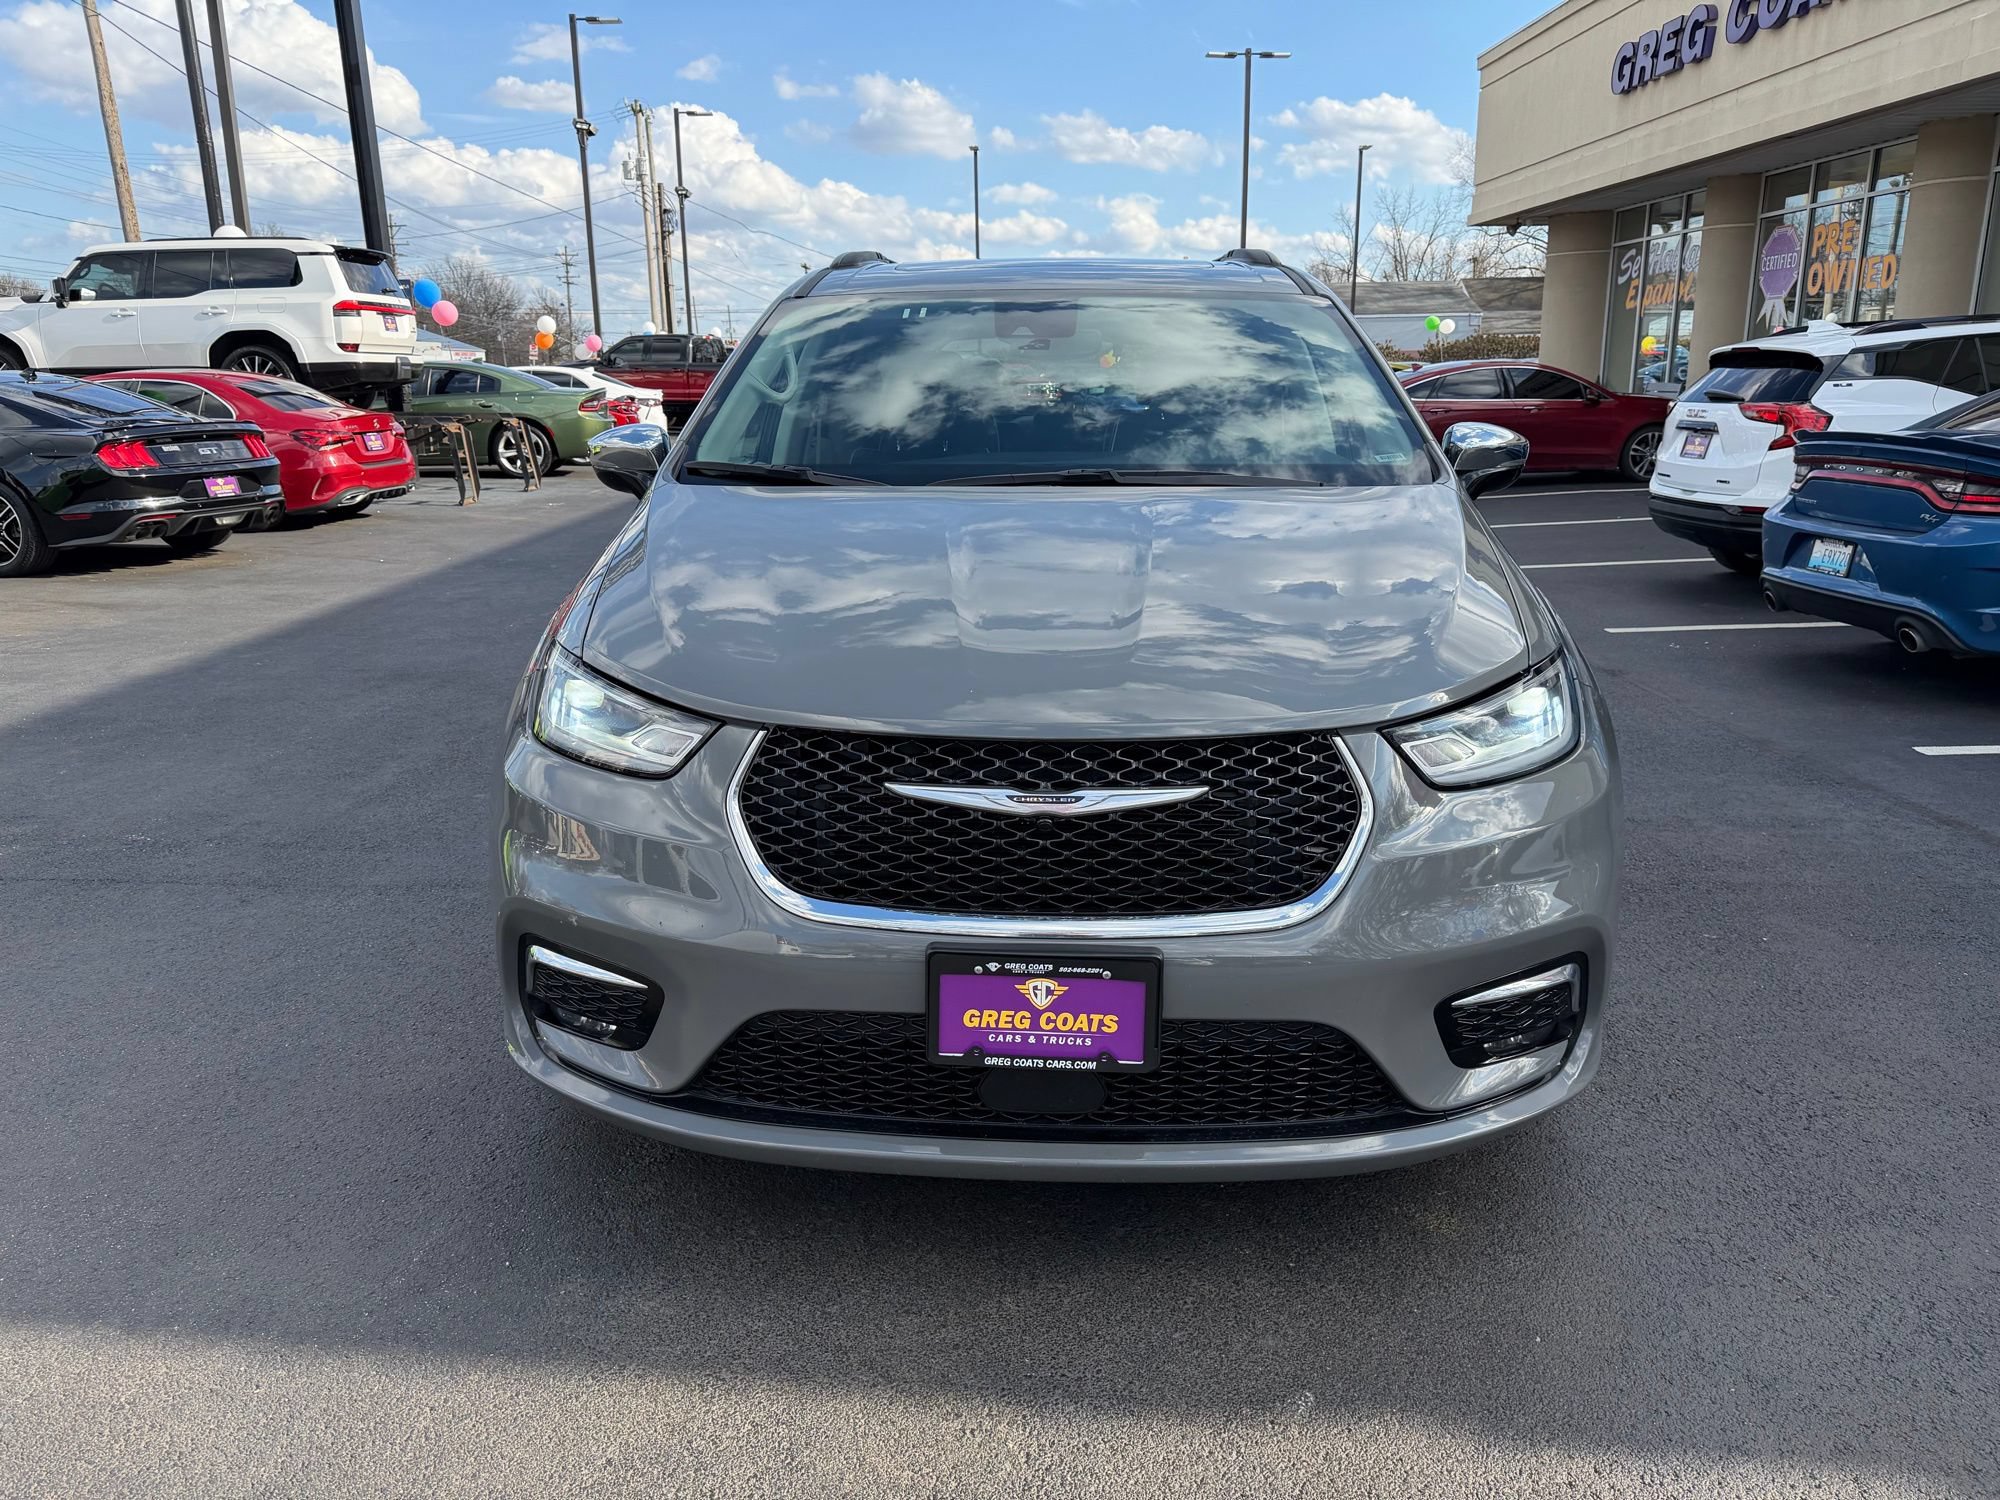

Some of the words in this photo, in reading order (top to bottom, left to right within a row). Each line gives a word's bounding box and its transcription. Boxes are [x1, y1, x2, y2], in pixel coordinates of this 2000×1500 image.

[1611, 5, 1718, 95] GREG
[1618, 248, 1641, 285] Se
[1761, 252, 1798, 272] CERTIFIED
[1807, 253, 1897, 296] OWNED
[1027, 963, 1053, 971] COATS
[963, 1008, 1032, 1030] GREG
[1039, 1011, 1119, 1034] COATS
[988, 1033, 1022, 1043] CARS
[1027, 1035, 1037, 1043] &
[1042, 1035, 1093, 1046] TRUCKS
[984, 1056, 1012, 1066] GREG
[1013, 1058, 1044, 1068] COATS
[1045, 1060, 1097, 1070] CARS.COM
